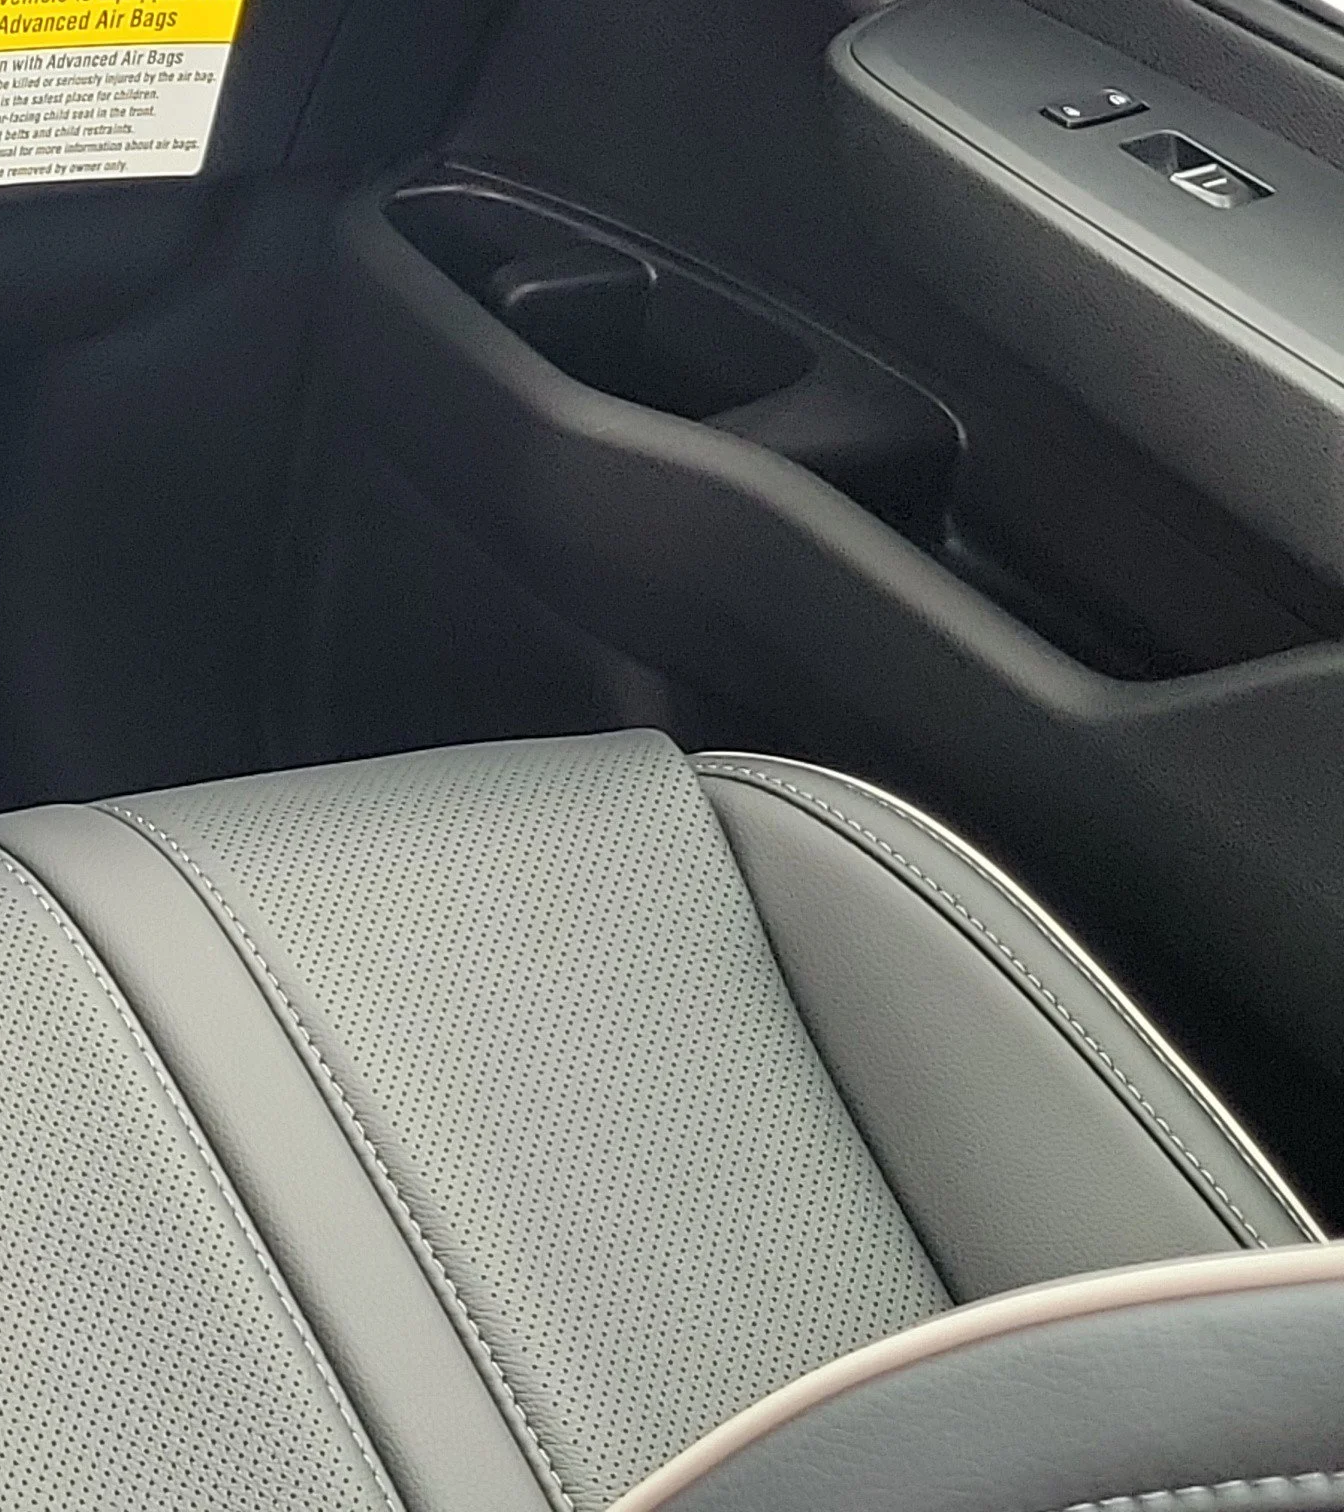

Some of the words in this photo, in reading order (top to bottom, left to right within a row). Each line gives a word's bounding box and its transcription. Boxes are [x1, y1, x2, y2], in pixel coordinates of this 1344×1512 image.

[95, 9, 125, 29] Air
[129, 8, 177, 31] Bags
[12, 55, 42, 72] with
[46, 53, 116, 70] Advanced
[121, 51, 142, 67] Air
[147, 50, 184, 66] Bags
[12, 77, 40, 90] killed
[43, 77, 54, 87] or
[56, 73, 102, 88] seriously
[105, 72, 140, 86] injured
[143, 71, 156, 85] by
[158, 70, 174, 82] the
[176, 70, 191, 82] air
[194, 70, 216, 84] bag.
[1, 96, 10, 107] is
[13, 94, 29, 106] the
[31, 92, 63, 105] safest
[65, 91, 94, 105] place
[96, 90, 111, 102] for
[114, 88, 159, 101] children.
[43, 108, 69, 121] child
[72, 108, 94, 119] seat
[97, 107, 107, 119] in
[110, 106, 126, 118] the
[4, 128, 30, 141] belts
[32, 127, 52, 139] and
[54, 125, 80, 137] child
[83, 122, 134, 135] restraints.
[19, 144, 33, 157] for
[35, 144, 62, 156] more
[64, 140, 122, 154] information
[124, 139, 153, 152] about
[155, 138, 170, 150] air
[172, 137, 199, 152] bags.
[7, 164, 52, 178] removed
[54, 163, 67, 176] by
[70, 162, 102, 174] owner
[104, 159, 128, 174] only.
